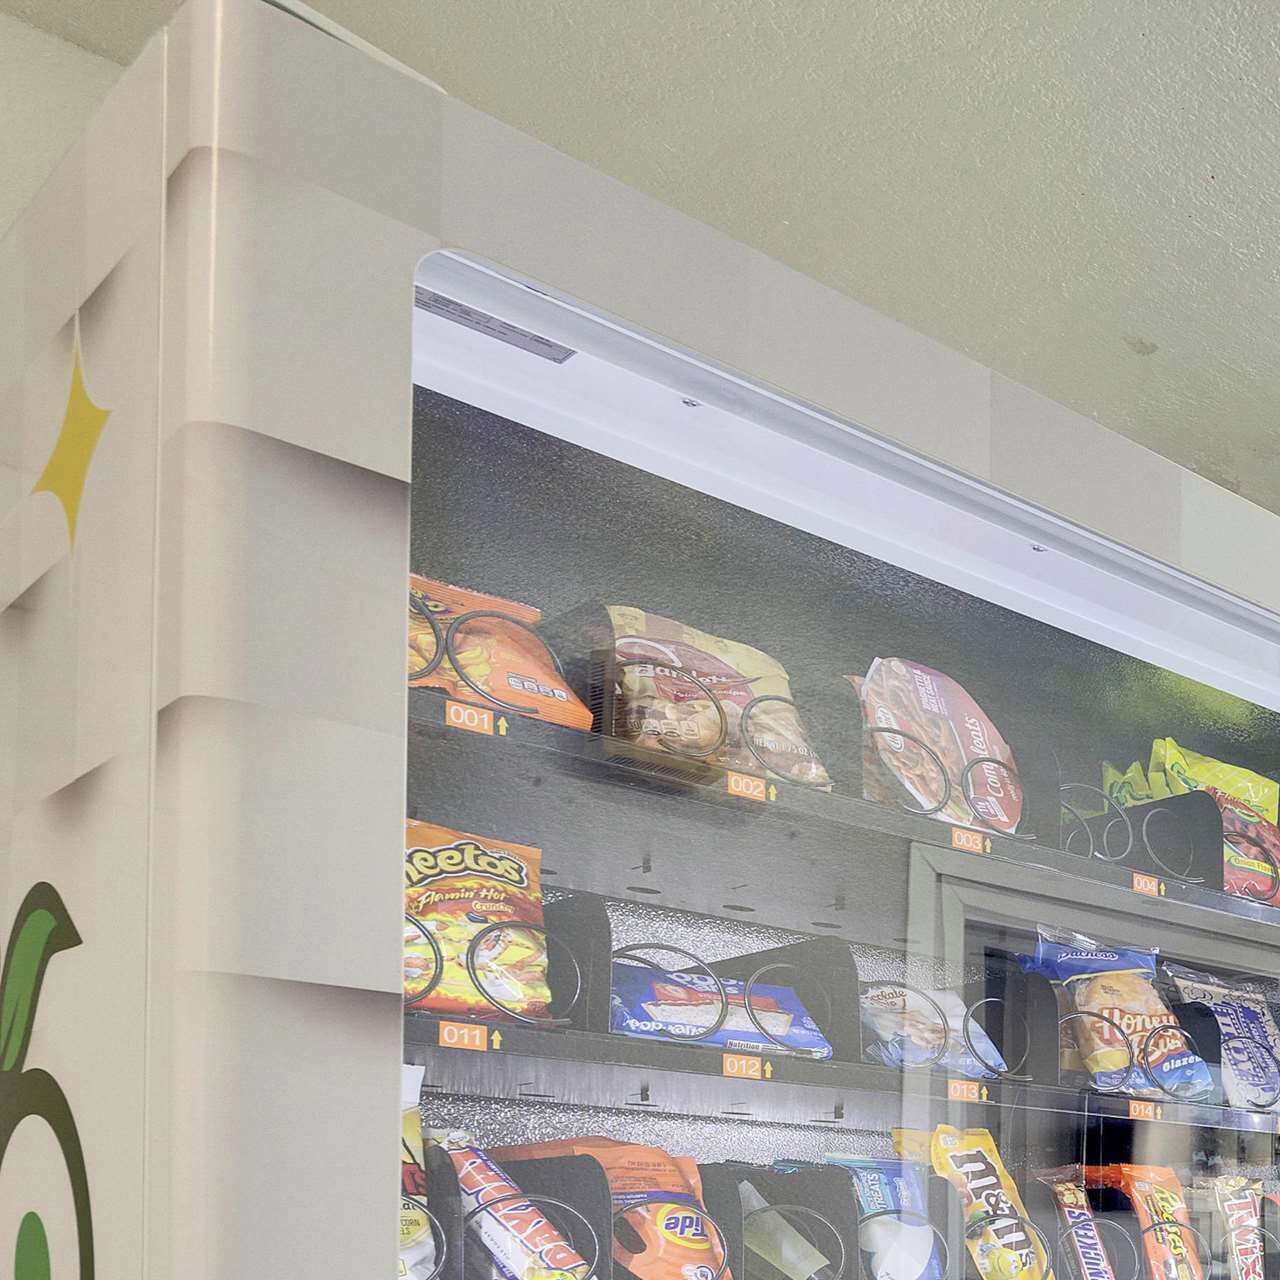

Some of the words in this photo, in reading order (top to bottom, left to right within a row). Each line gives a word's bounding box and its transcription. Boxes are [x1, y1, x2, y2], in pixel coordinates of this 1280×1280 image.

[450, 706, 489, 729] 001
[731, 777, 764, 796] 002
[955, 832, 981, 848] 003
[406, 845, 523, 883] heetos
[1135, 877, 1156, 892] 004
[480, 888, 508, 900] Hot
[1100, 1009, 1179, 1039] Honey
[443, 1026, 481, 1046] 011
[726, 1059, 760, 1076] 012
[951, 1084, 977, 1098] 013
[1132, 1103, 1153, 1115] 014
[400, 1219, 420, 1227] CORN
[665, 1215, 708, 1237] Tide
[1225, 1191, 1263, 1280] TWIX
